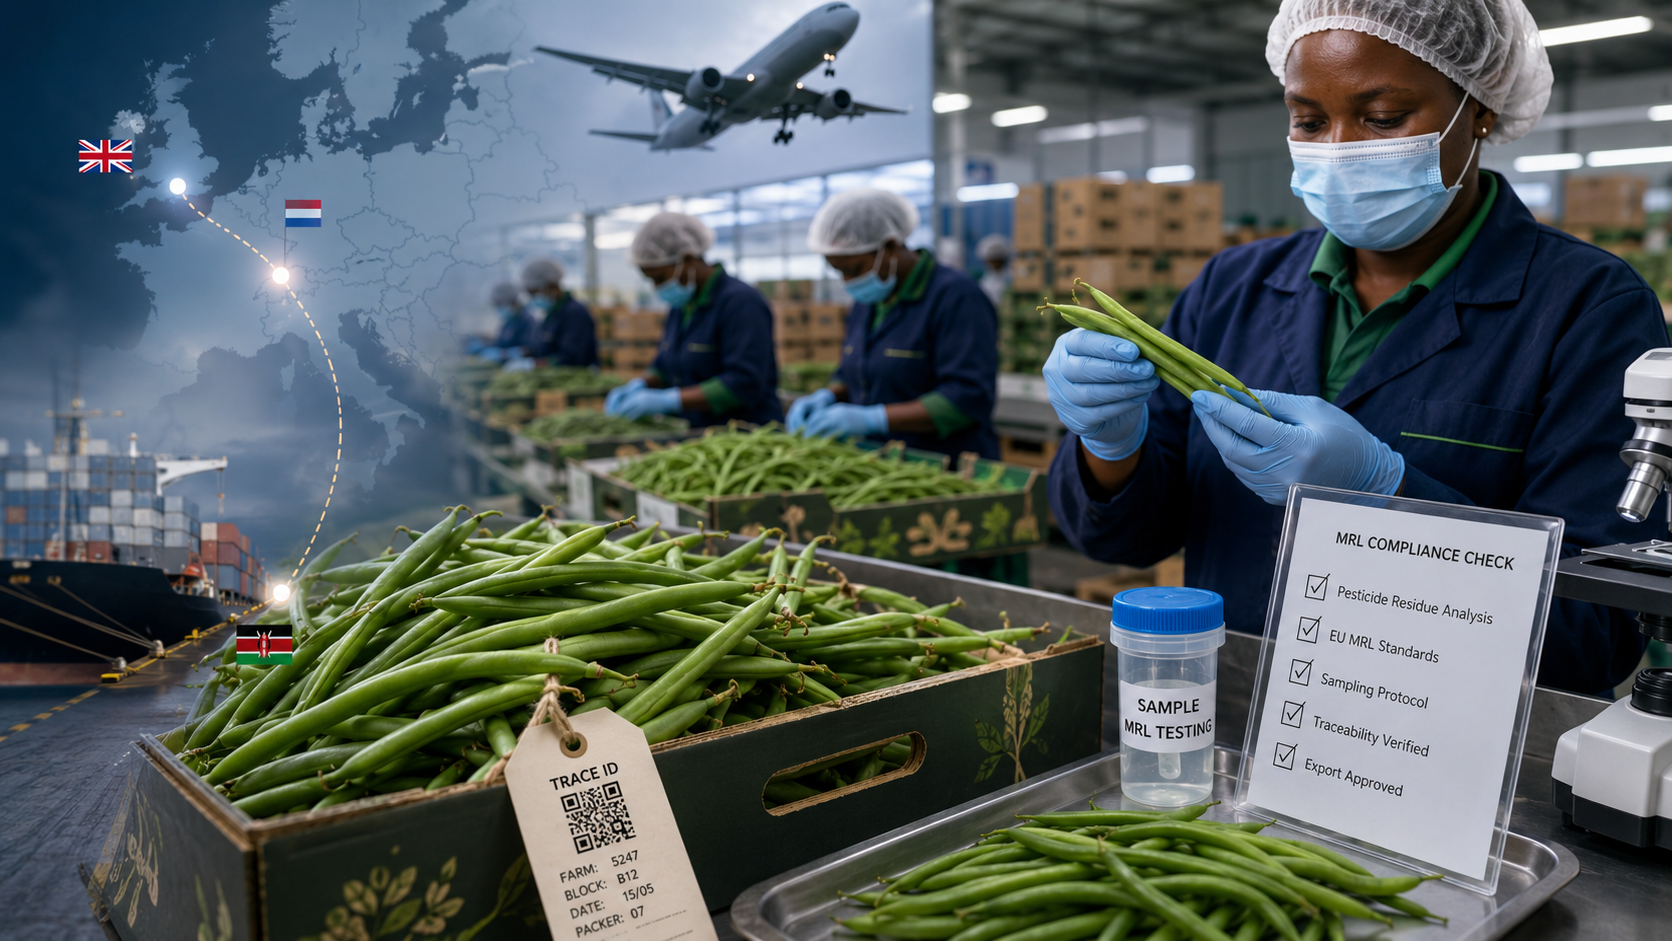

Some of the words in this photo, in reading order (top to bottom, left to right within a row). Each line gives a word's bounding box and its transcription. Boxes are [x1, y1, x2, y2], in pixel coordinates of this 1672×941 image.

[1336, 532, 1363, 547] MRL
[1368, 537, 1460, 562] COMPLIANCE
[1464, 551, 1514, 570] CHECK
[1338, 586, 1388, 605] Pesticide
[1392, 595, 1438, 614] Residue
[1442, 605, 1493, 624] Analysis
[1330, 630, 1346, 643] EU
[1349, 634, 1374, 649] MRL
[1379, 640, 1439, 663] Standards
[1138, 698, 1199, 714] SAMPLE
[1321, 673, 1374, 698] Sampling
[1378, 686, 1428, 709] Protocol
[1125, 719, 1151, 737] MRL
[1156, 719, 1212, 739] TESTING
[1314, 716, 1379, 746] Traceability
[1383, 734, 1429, 757] Verified
[549, 767, 600, 790] TRACE
[603, 762, 618, 776] ID
[1305, 758, 1341, 779] Export
[1344, 770, 1403, 796] Approved
[559, 864, 598, 884] FARM:
[611, 850, 638, 867] 5247
[564, 880, 607, 901] BLOCK:
[617, 869, 638, 884] B12
[570, 900, 605, 919] DATE:
[623, 883, 654, 901] 15/05
[576, 914, 624, 937] PACKER:
[630, 905, 644, 919] 07
